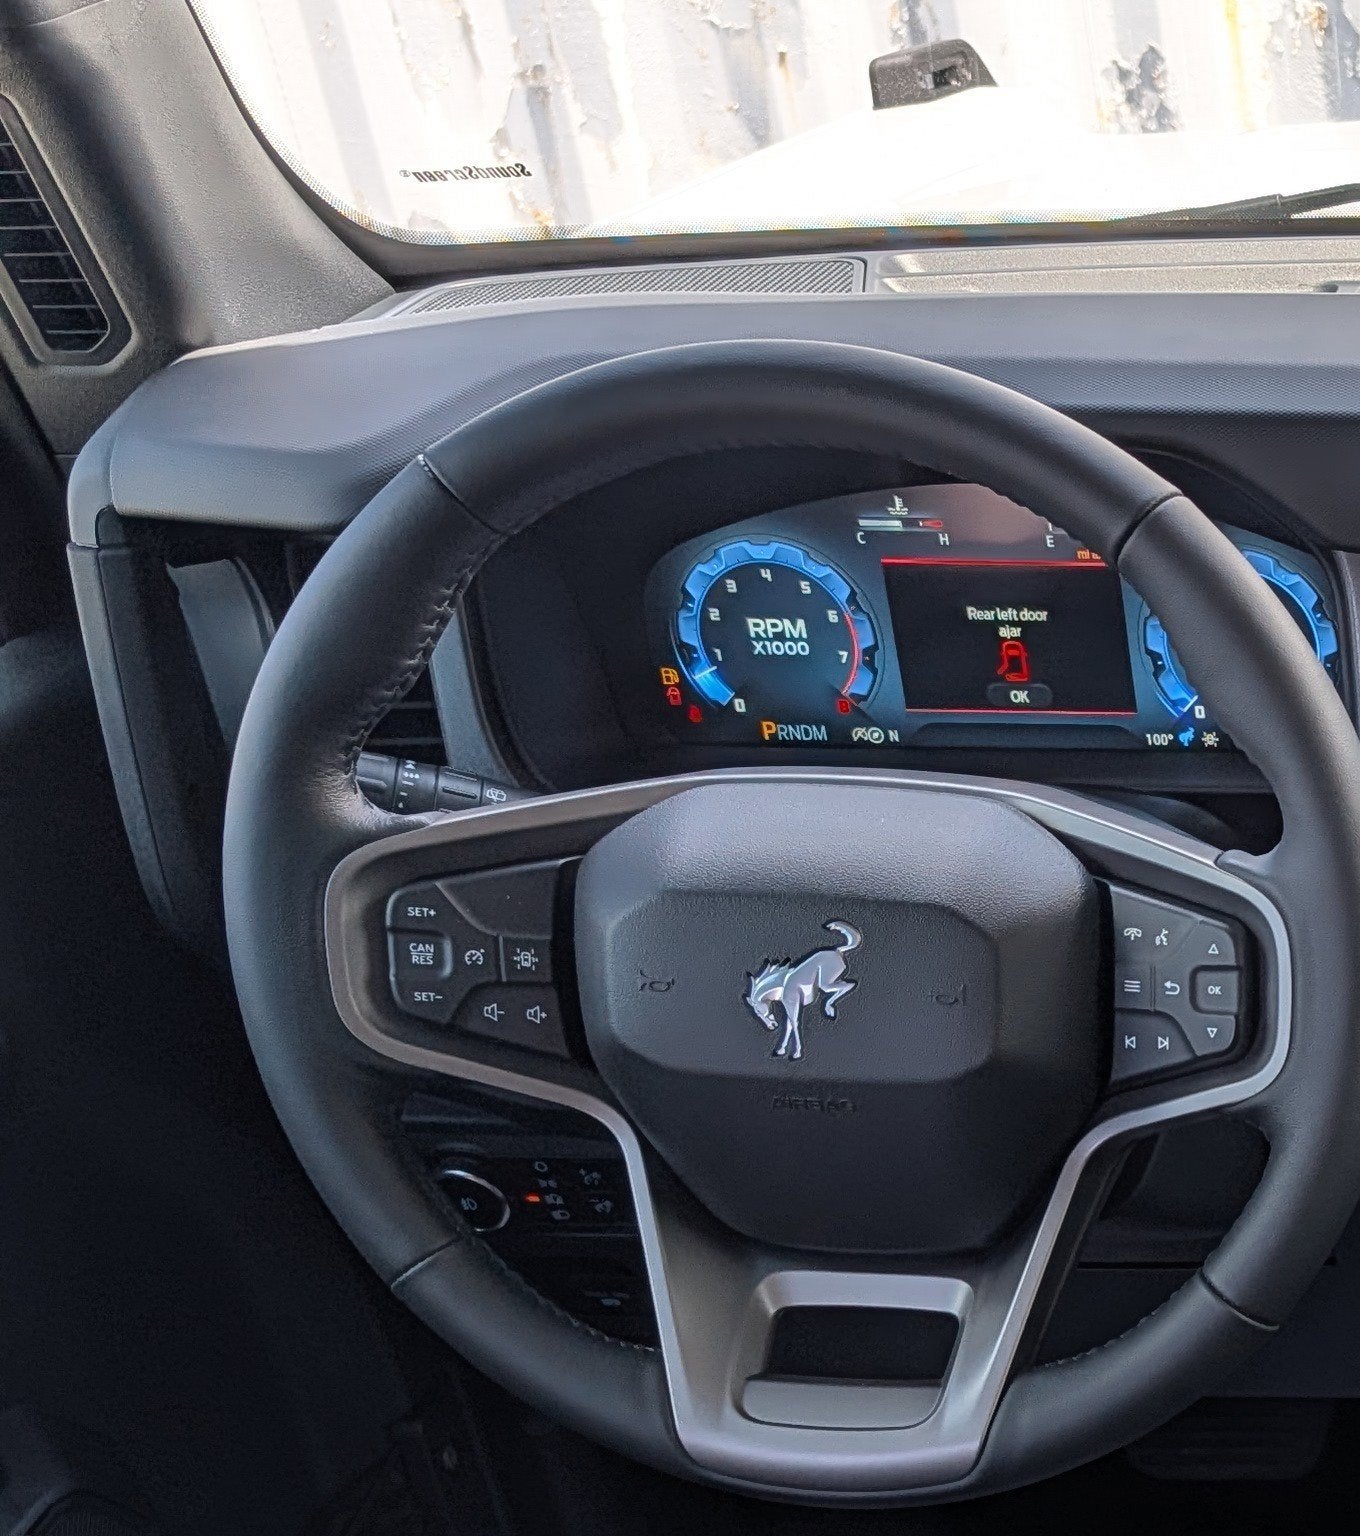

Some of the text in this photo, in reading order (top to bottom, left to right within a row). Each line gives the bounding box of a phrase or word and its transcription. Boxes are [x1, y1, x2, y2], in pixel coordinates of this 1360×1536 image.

[939, 533, 950, 546] H
[1046, 535, 1055, 548] E
[760, 568, 773, 582] 4
[725, 579, 738, 594] 3
[800, 581, 812, 595] 5
[708, 608, 721, 621] 2
[965, 606, 1048, 622] Rear left door
[747, 617, 808, 639] RPM
[998, 625, 1022, 640] ajar
[752, 641, 810, 656] X1000
[838, 651, 849, 664] 7
[1009, 690, 1030, 704] OK
[889, 729, 900, 743] N
[409, 942, 434, 953] CAN
[412, 955, 434, 965] RES
[1207, 986, 1222, 995] OK
